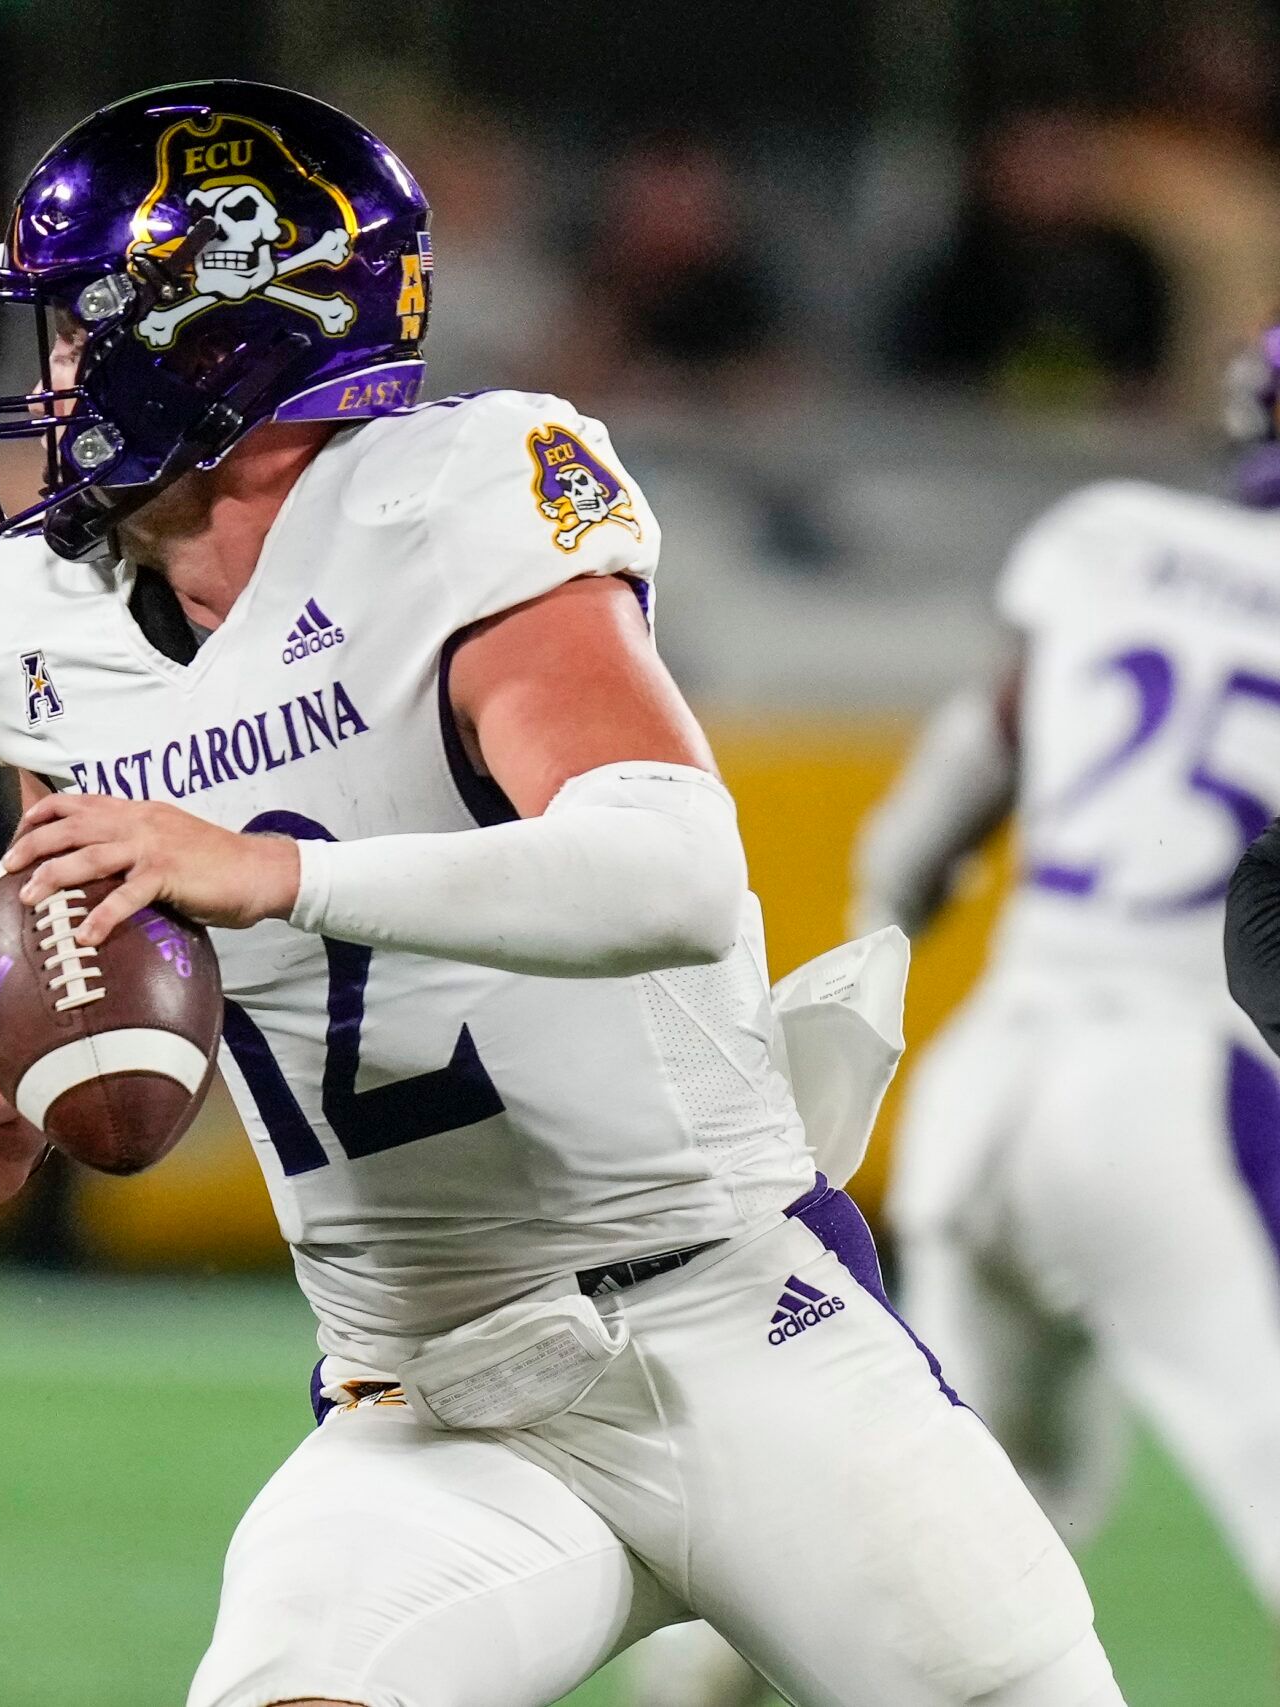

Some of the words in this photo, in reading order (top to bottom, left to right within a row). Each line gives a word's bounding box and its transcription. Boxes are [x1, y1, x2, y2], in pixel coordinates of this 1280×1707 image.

[183, 139, 254, 176] ECU
[337, 381, 401, 411] EAST
[544, 443, 575, 467] ECU
[283, 627, 344, 665] adidas
[162, 681, 369, 798] CAROLINA
[768, 1294, 846, 1346] adidas
